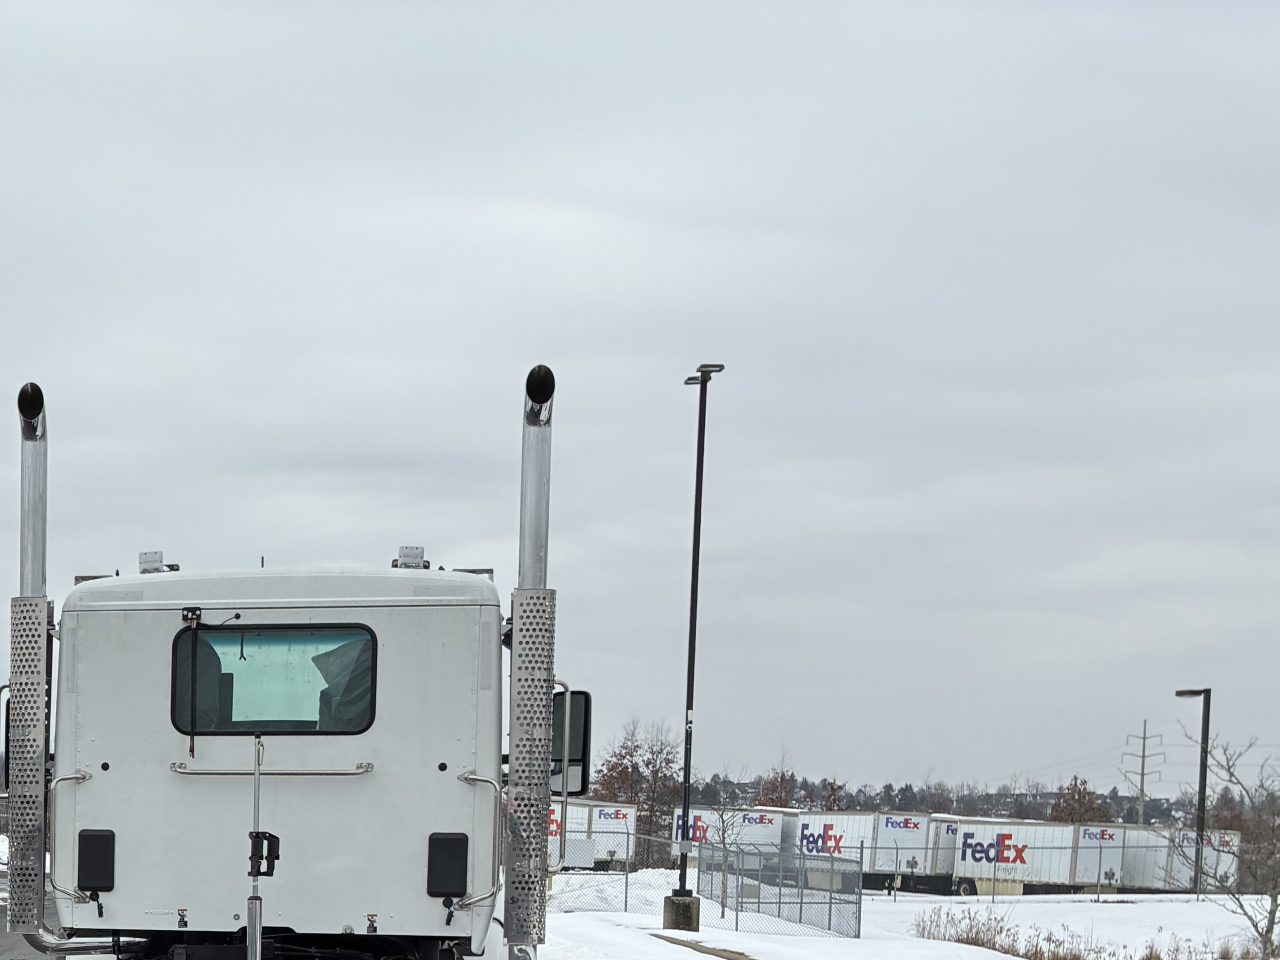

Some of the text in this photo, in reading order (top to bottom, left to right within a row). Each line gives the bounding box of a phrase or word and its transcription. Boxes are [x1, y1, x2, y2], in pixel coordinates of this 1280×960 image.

[598, 809, 629, 820] FedEx
[742, 814, 774, 825] FedEx
[885, 817, 920, 830] FedEx
[800, 823, 844, 854] FedEx
[1083, 828, 1115, 841] FedEx
[961, 832, 1029, 864] FedEx
